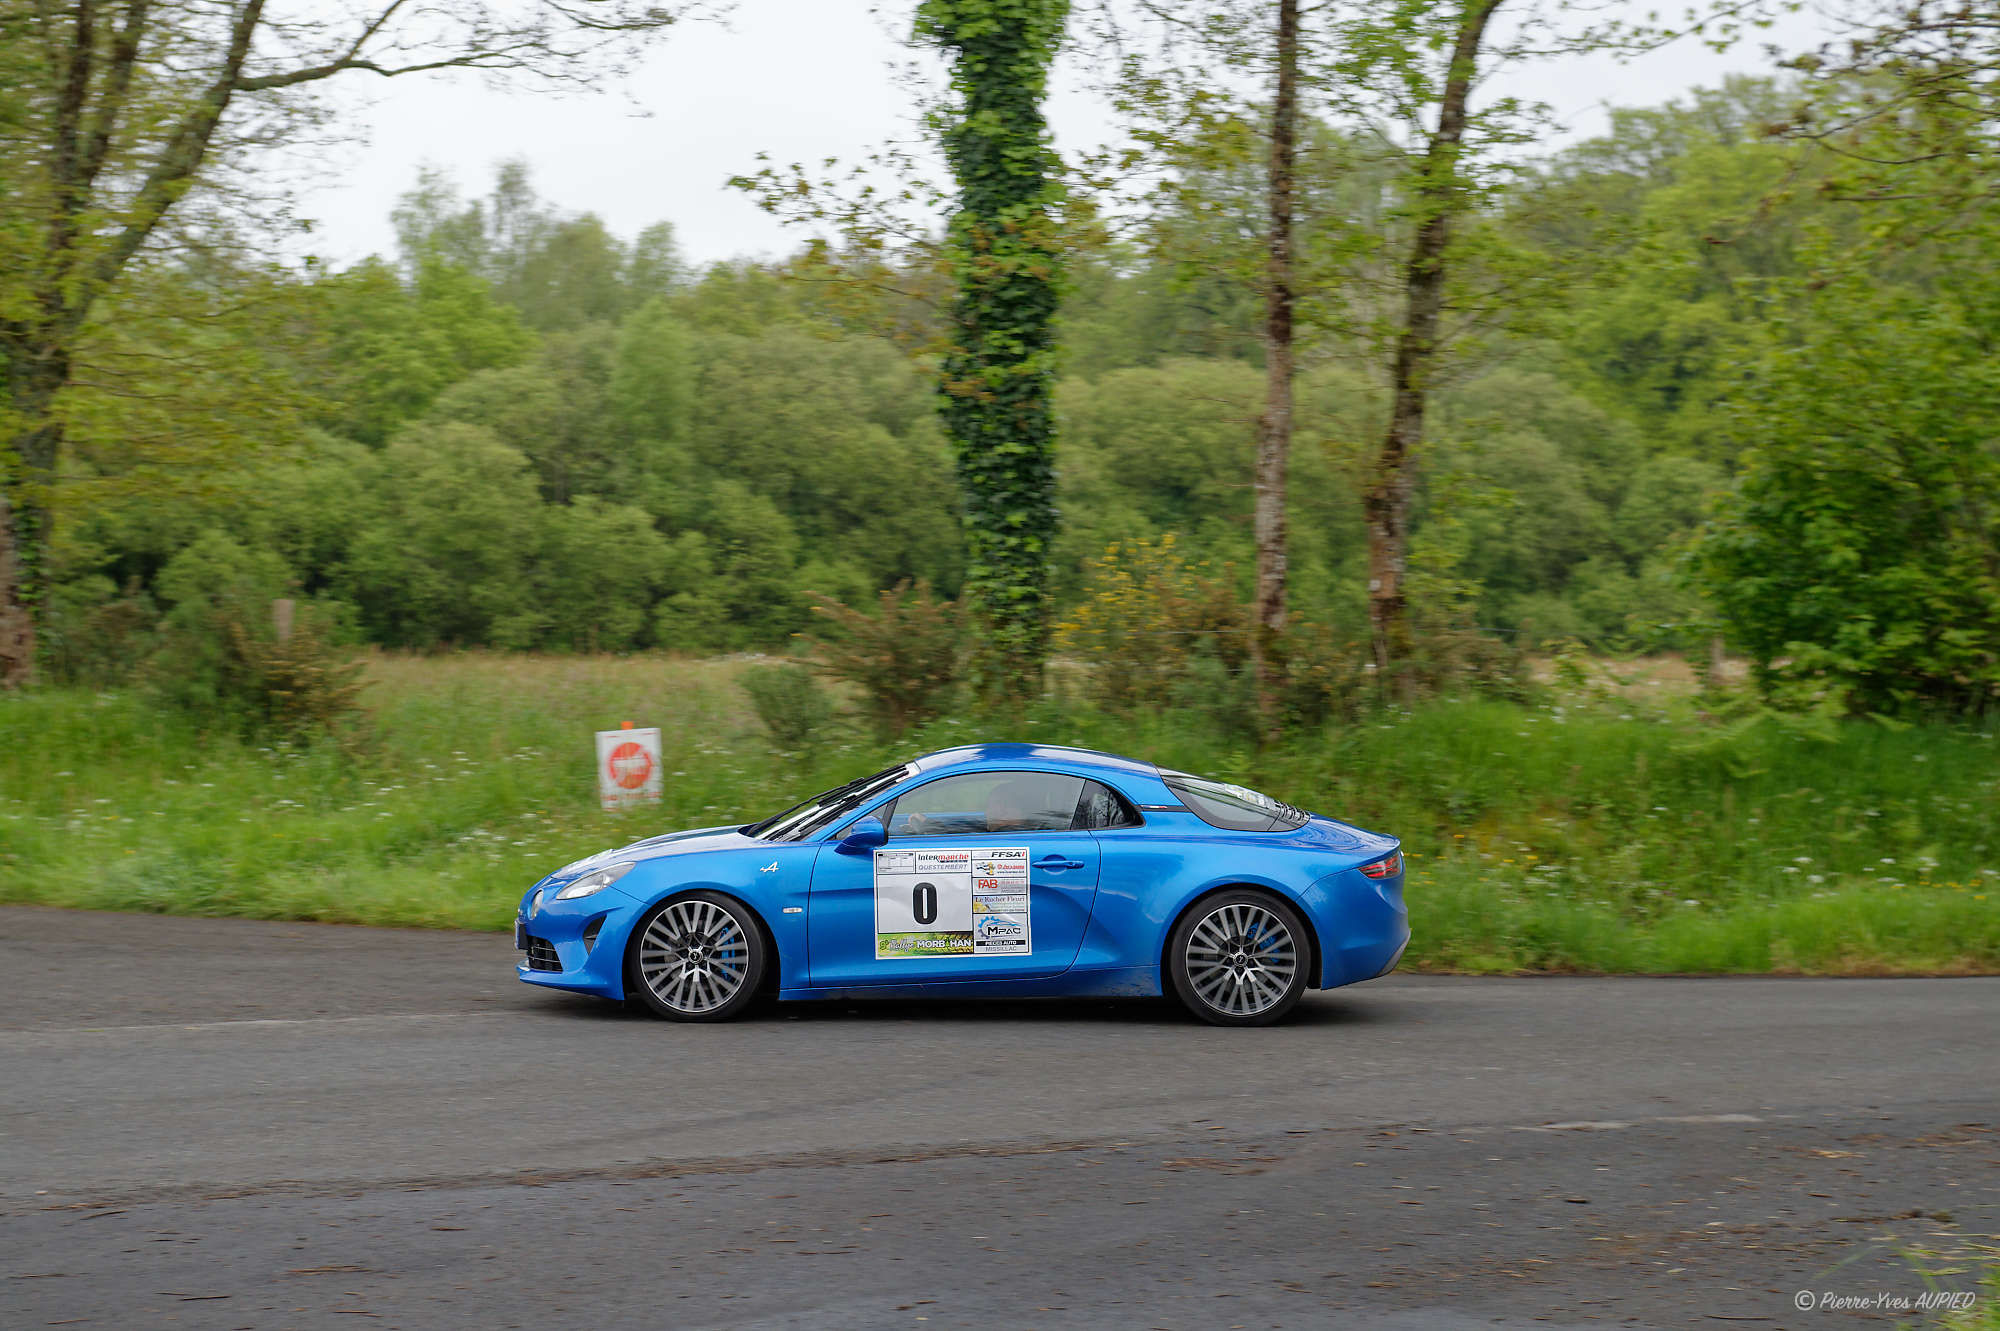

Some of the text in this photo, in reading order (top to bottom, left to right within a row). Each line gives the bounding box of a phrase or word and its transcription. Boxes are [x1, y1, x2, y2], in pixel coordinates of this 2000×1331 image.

[918, 863, 968, 871] QUESTEMBERT
[978, 879, 998, 889] FAB
[912, 882, 938, 925] 0
[987, 926, 1021, 936] MPAC
